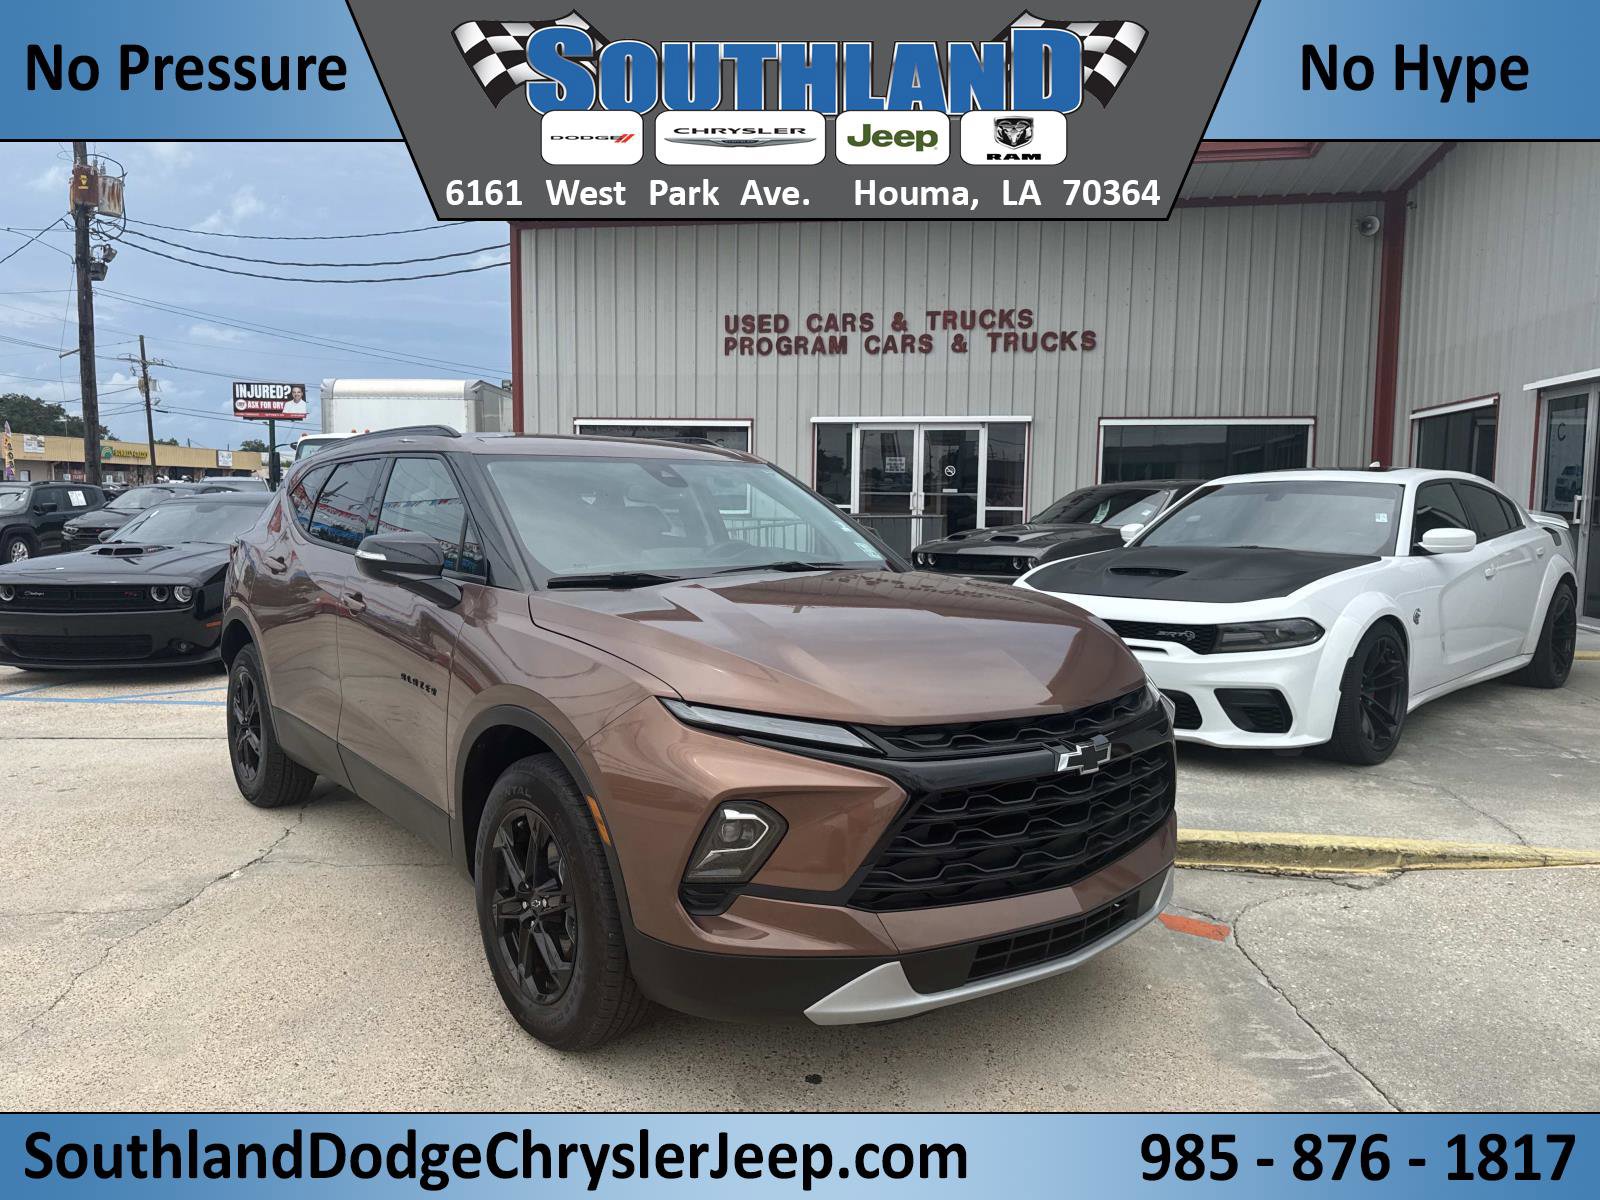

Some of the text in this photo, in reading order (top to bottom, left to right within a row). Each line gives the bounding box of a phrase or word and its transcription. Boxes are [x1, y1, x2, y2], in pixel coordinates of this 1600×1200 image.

[724, 308, 1034, 335] USED CARS & TRUCKS
[724, 330, 1097, 356] PROGRAM CARS & TRUCKS
[235, 383, 292, 399] INJURED?
[247, 400, 259, 409] ASK
[260, 400, 271, 409] FOR
